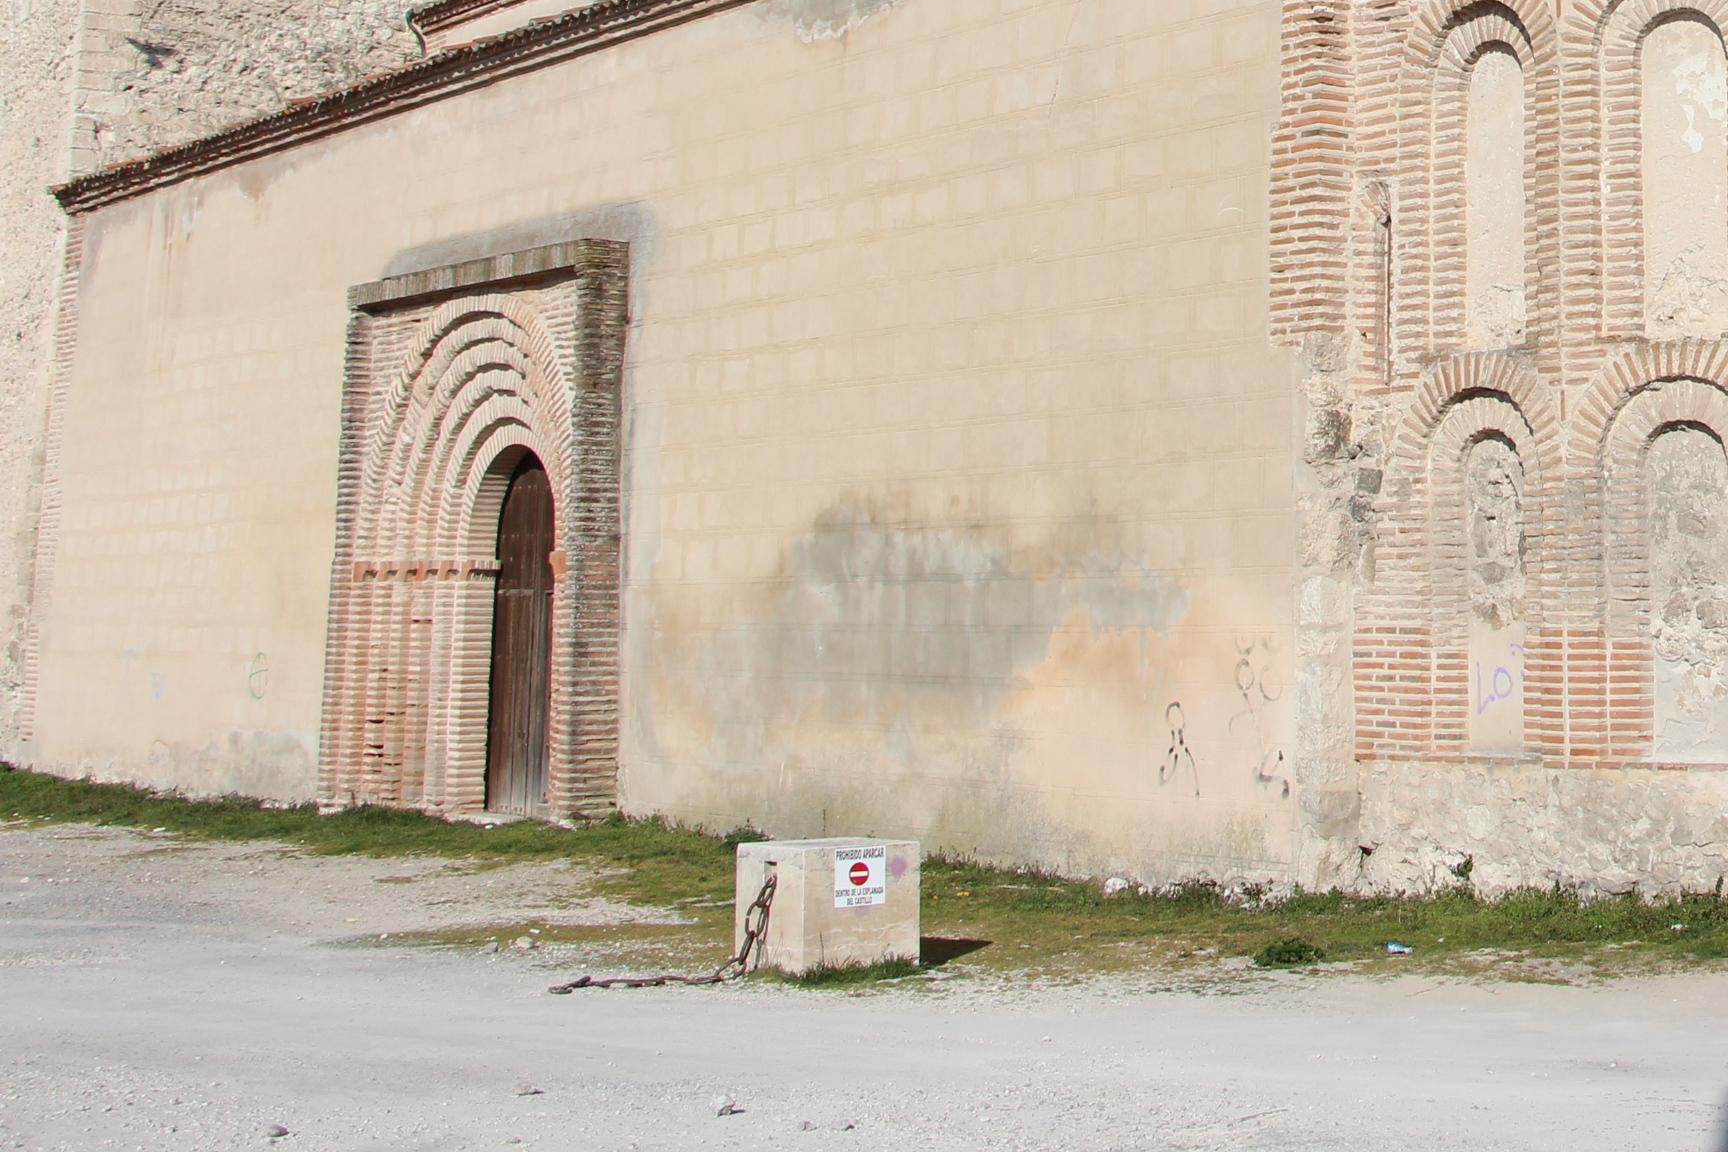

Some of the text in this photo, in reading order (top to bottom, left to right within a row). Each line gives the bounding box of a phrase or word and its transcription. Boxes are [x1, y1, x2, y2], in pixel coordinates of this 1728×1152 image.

[836, 847, 884, 861] PROHIBIDO APARCAR
[836, 889, 850, 897] DENTRO
[855, 897, 872, 905] CASTILLO
